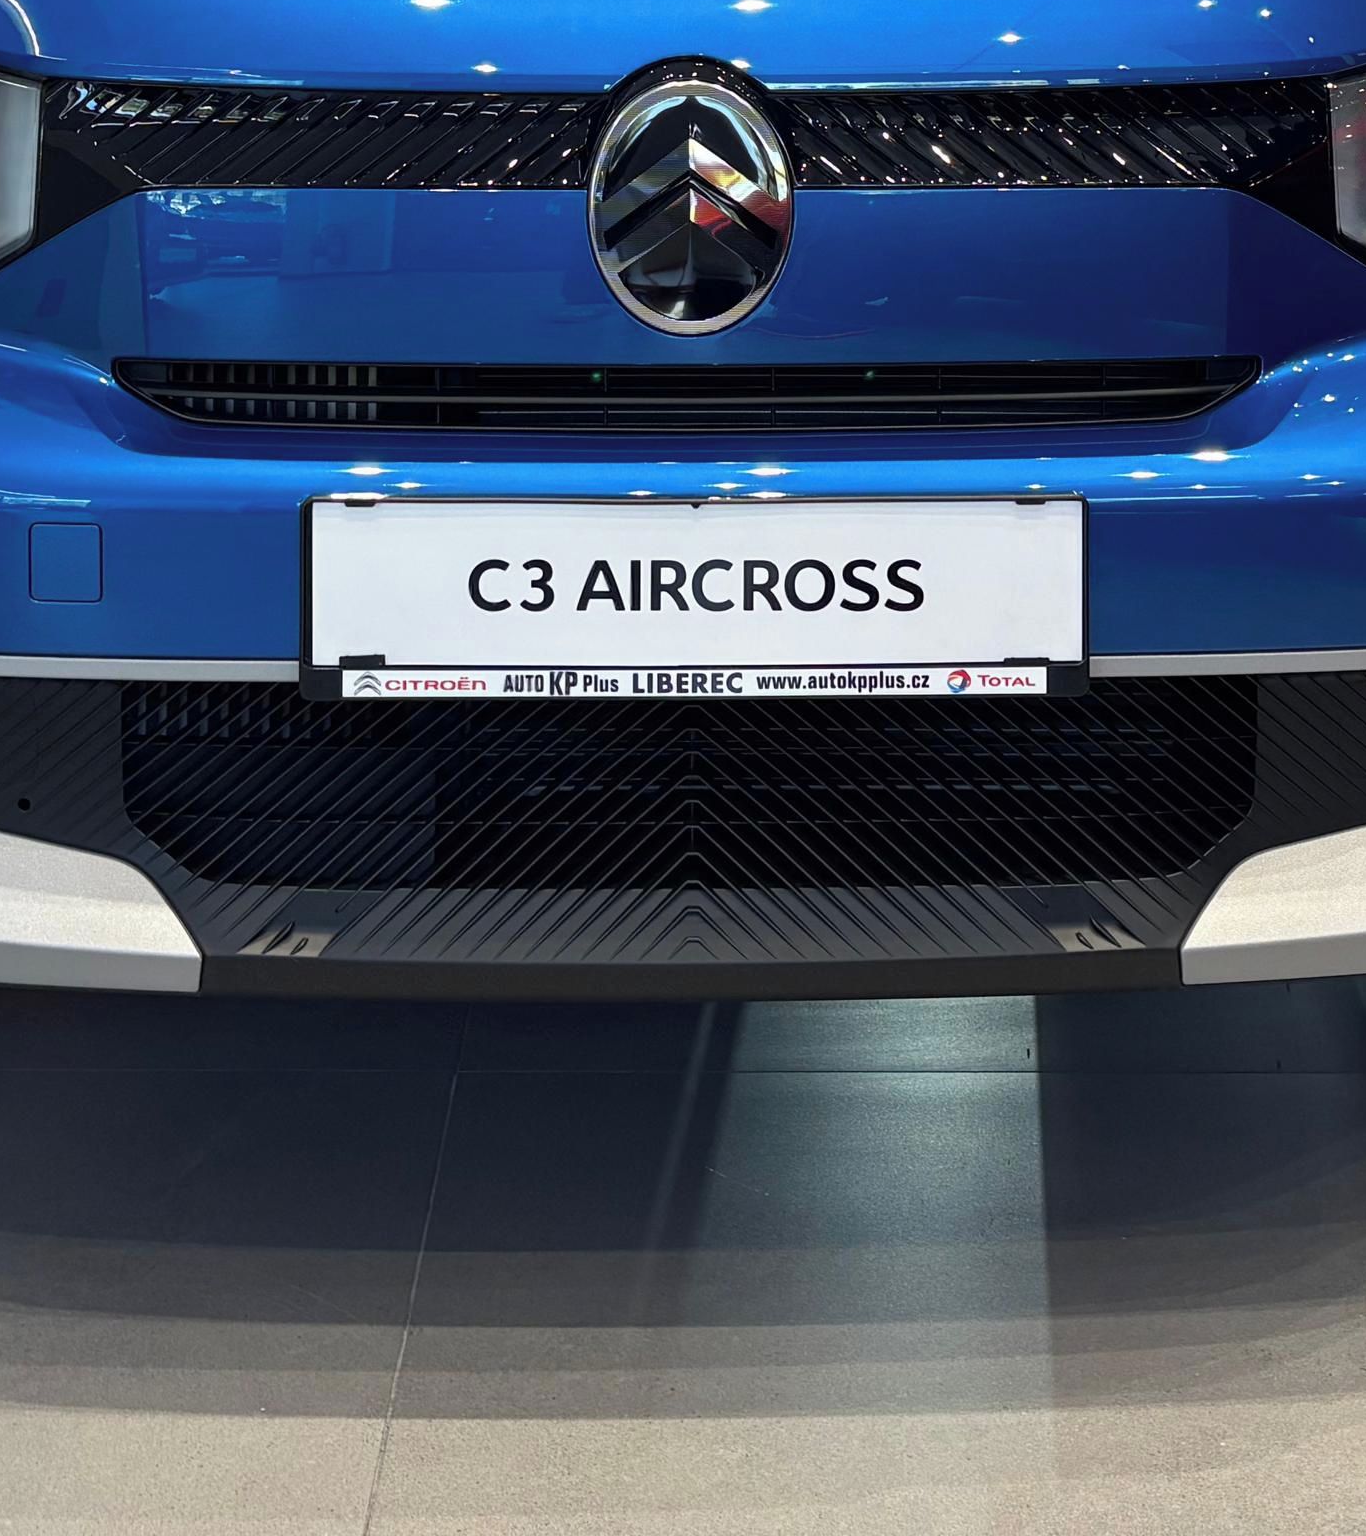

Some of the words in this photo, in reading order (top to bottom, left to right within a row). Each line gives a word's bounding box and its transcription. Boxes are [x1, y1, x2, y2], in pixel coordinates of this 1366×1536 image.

[468, 558, 555, 612] C3
[576, 558, 925, 612] AIRCROSS
[502, 674, 545, 693] AUTO
[549, 671, 578, 696] KP
[583, 674, 620, 693] Plus
[632, 671, 744, 694] LIBEREC
[756, 671, 931, 693] www.autokpplus.cz
